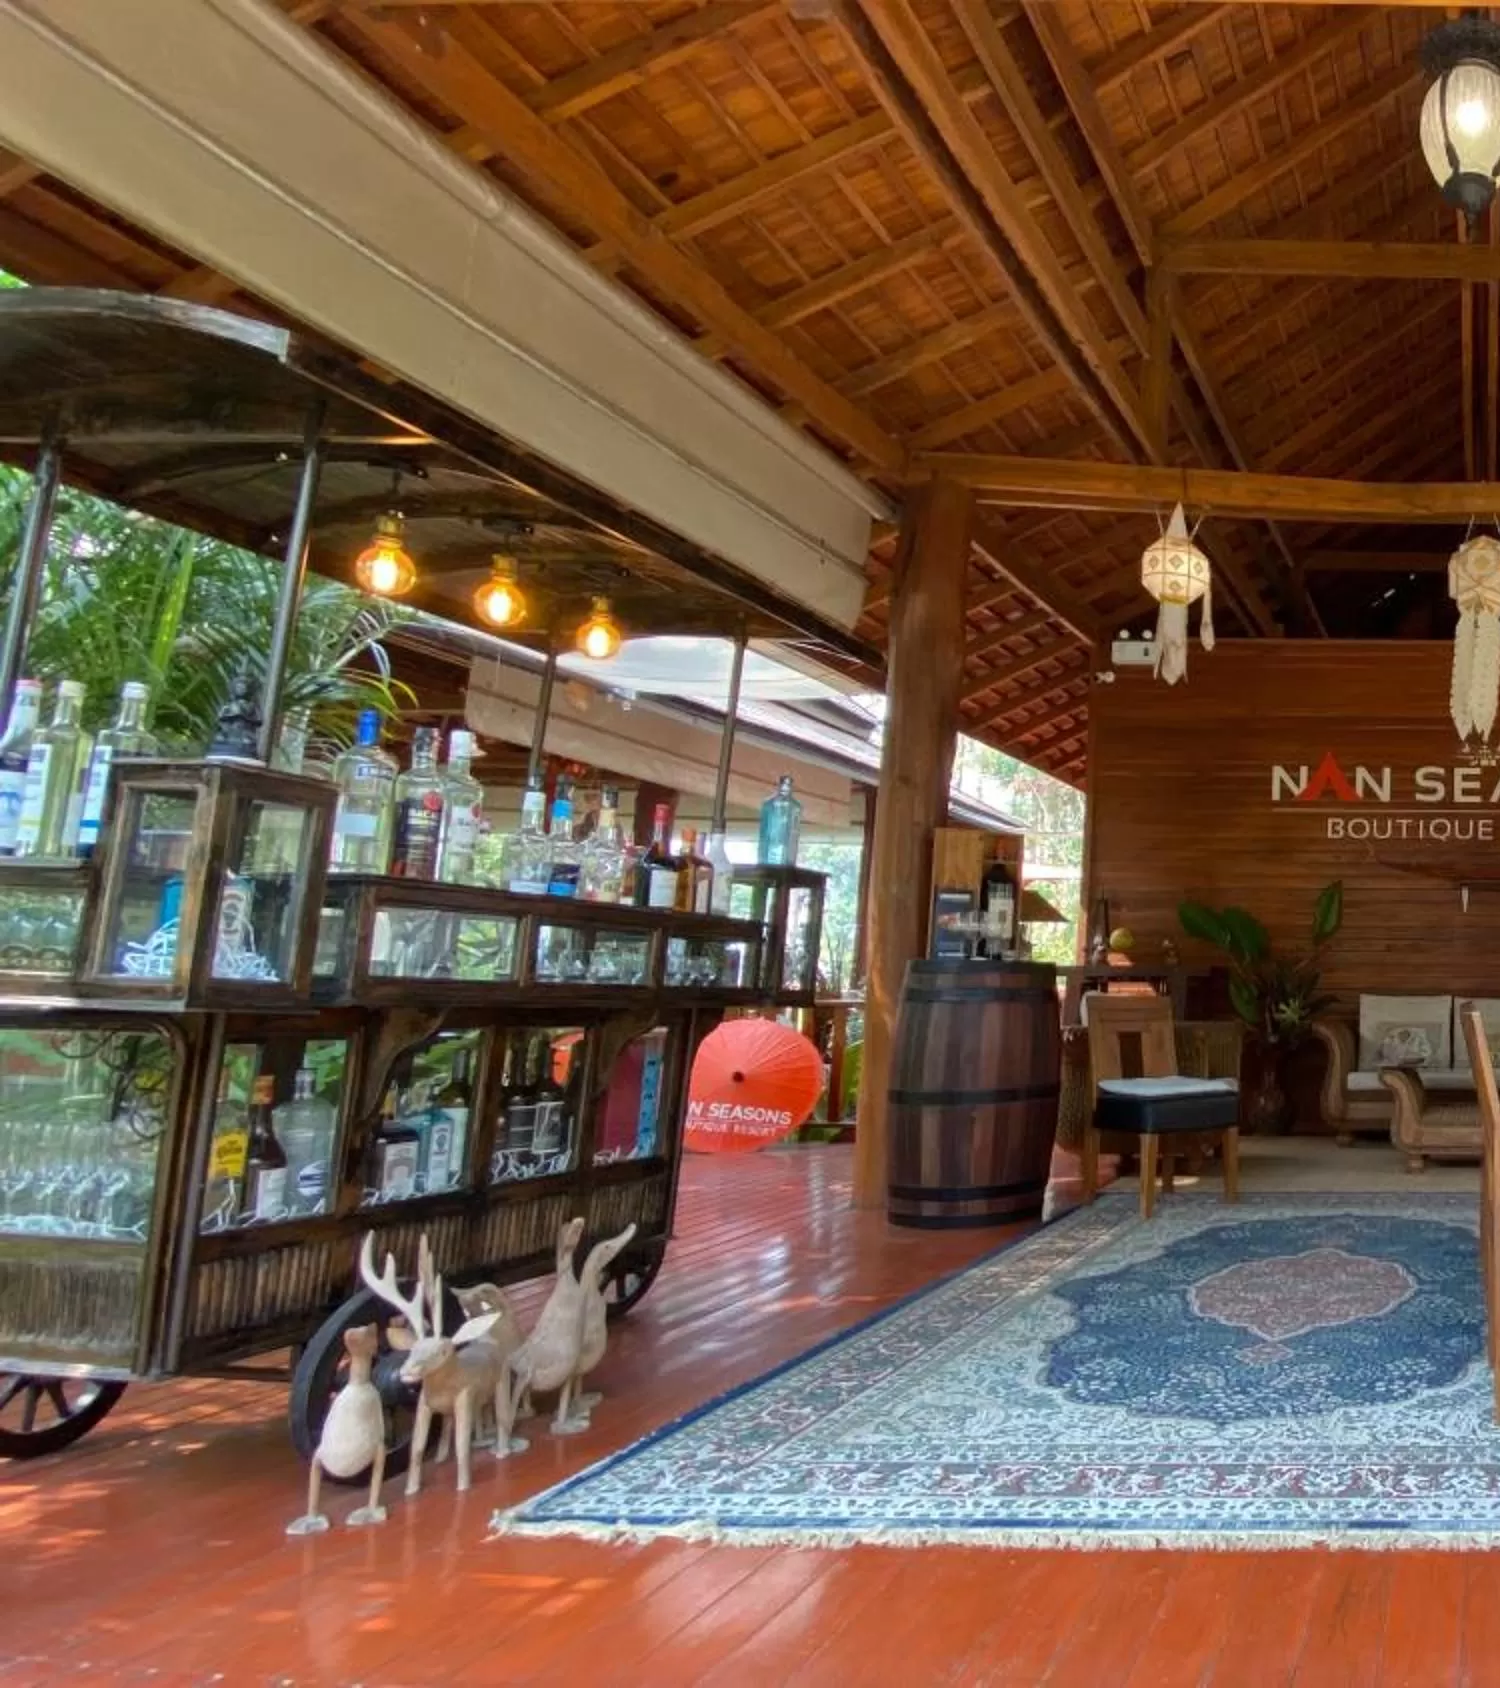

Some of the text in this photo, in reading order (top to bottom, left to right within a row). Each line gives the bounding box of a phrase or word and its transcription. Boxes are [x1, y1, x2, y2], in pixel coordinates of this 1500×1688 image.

[1271, 752, 1391, 802] NAN
[1327, 817, 1494, 841] BOUTIQUE
[707, 1103, 793, 1125] SEASONS
